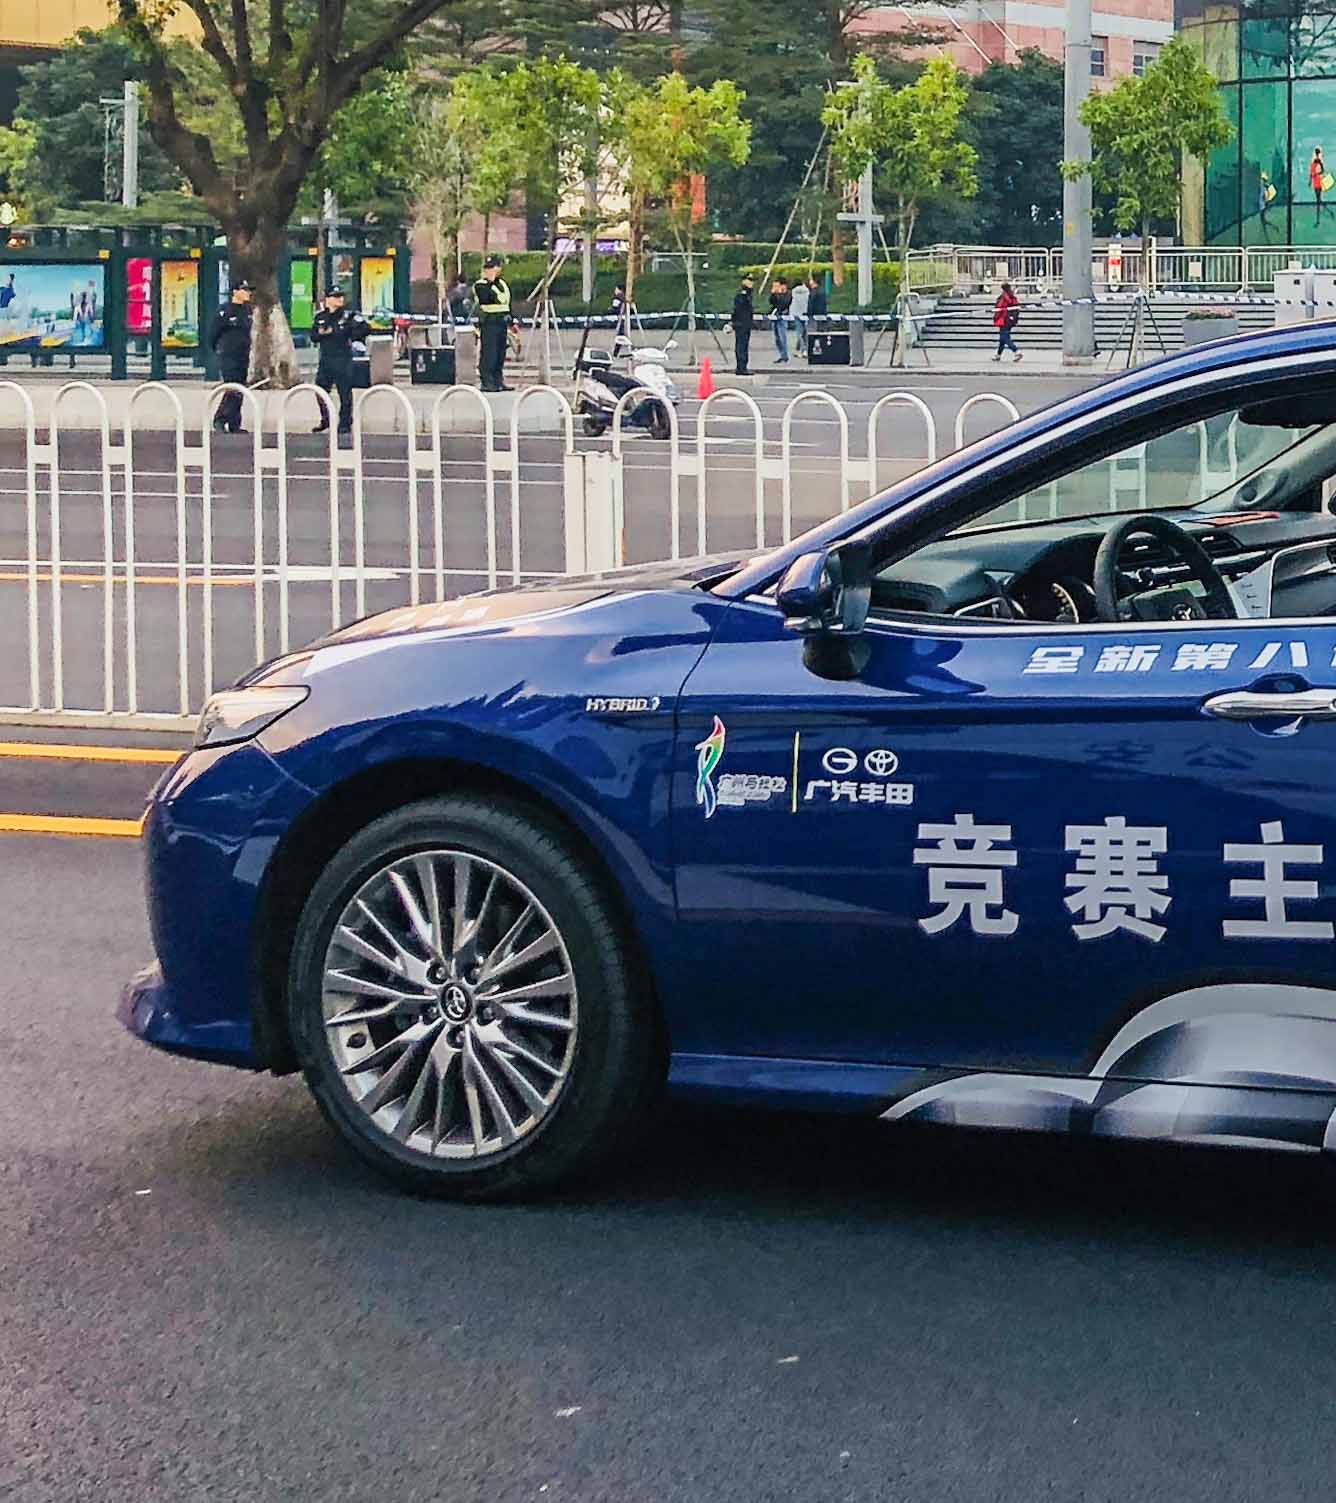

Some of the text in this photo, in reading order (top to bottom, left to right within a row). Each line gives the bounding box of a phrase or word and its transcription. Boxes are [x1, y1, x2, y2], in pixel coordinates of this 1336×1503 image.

[585, 698, 648, 712] HYBRID
[804, 779, 914, 805] 广汽丰田
